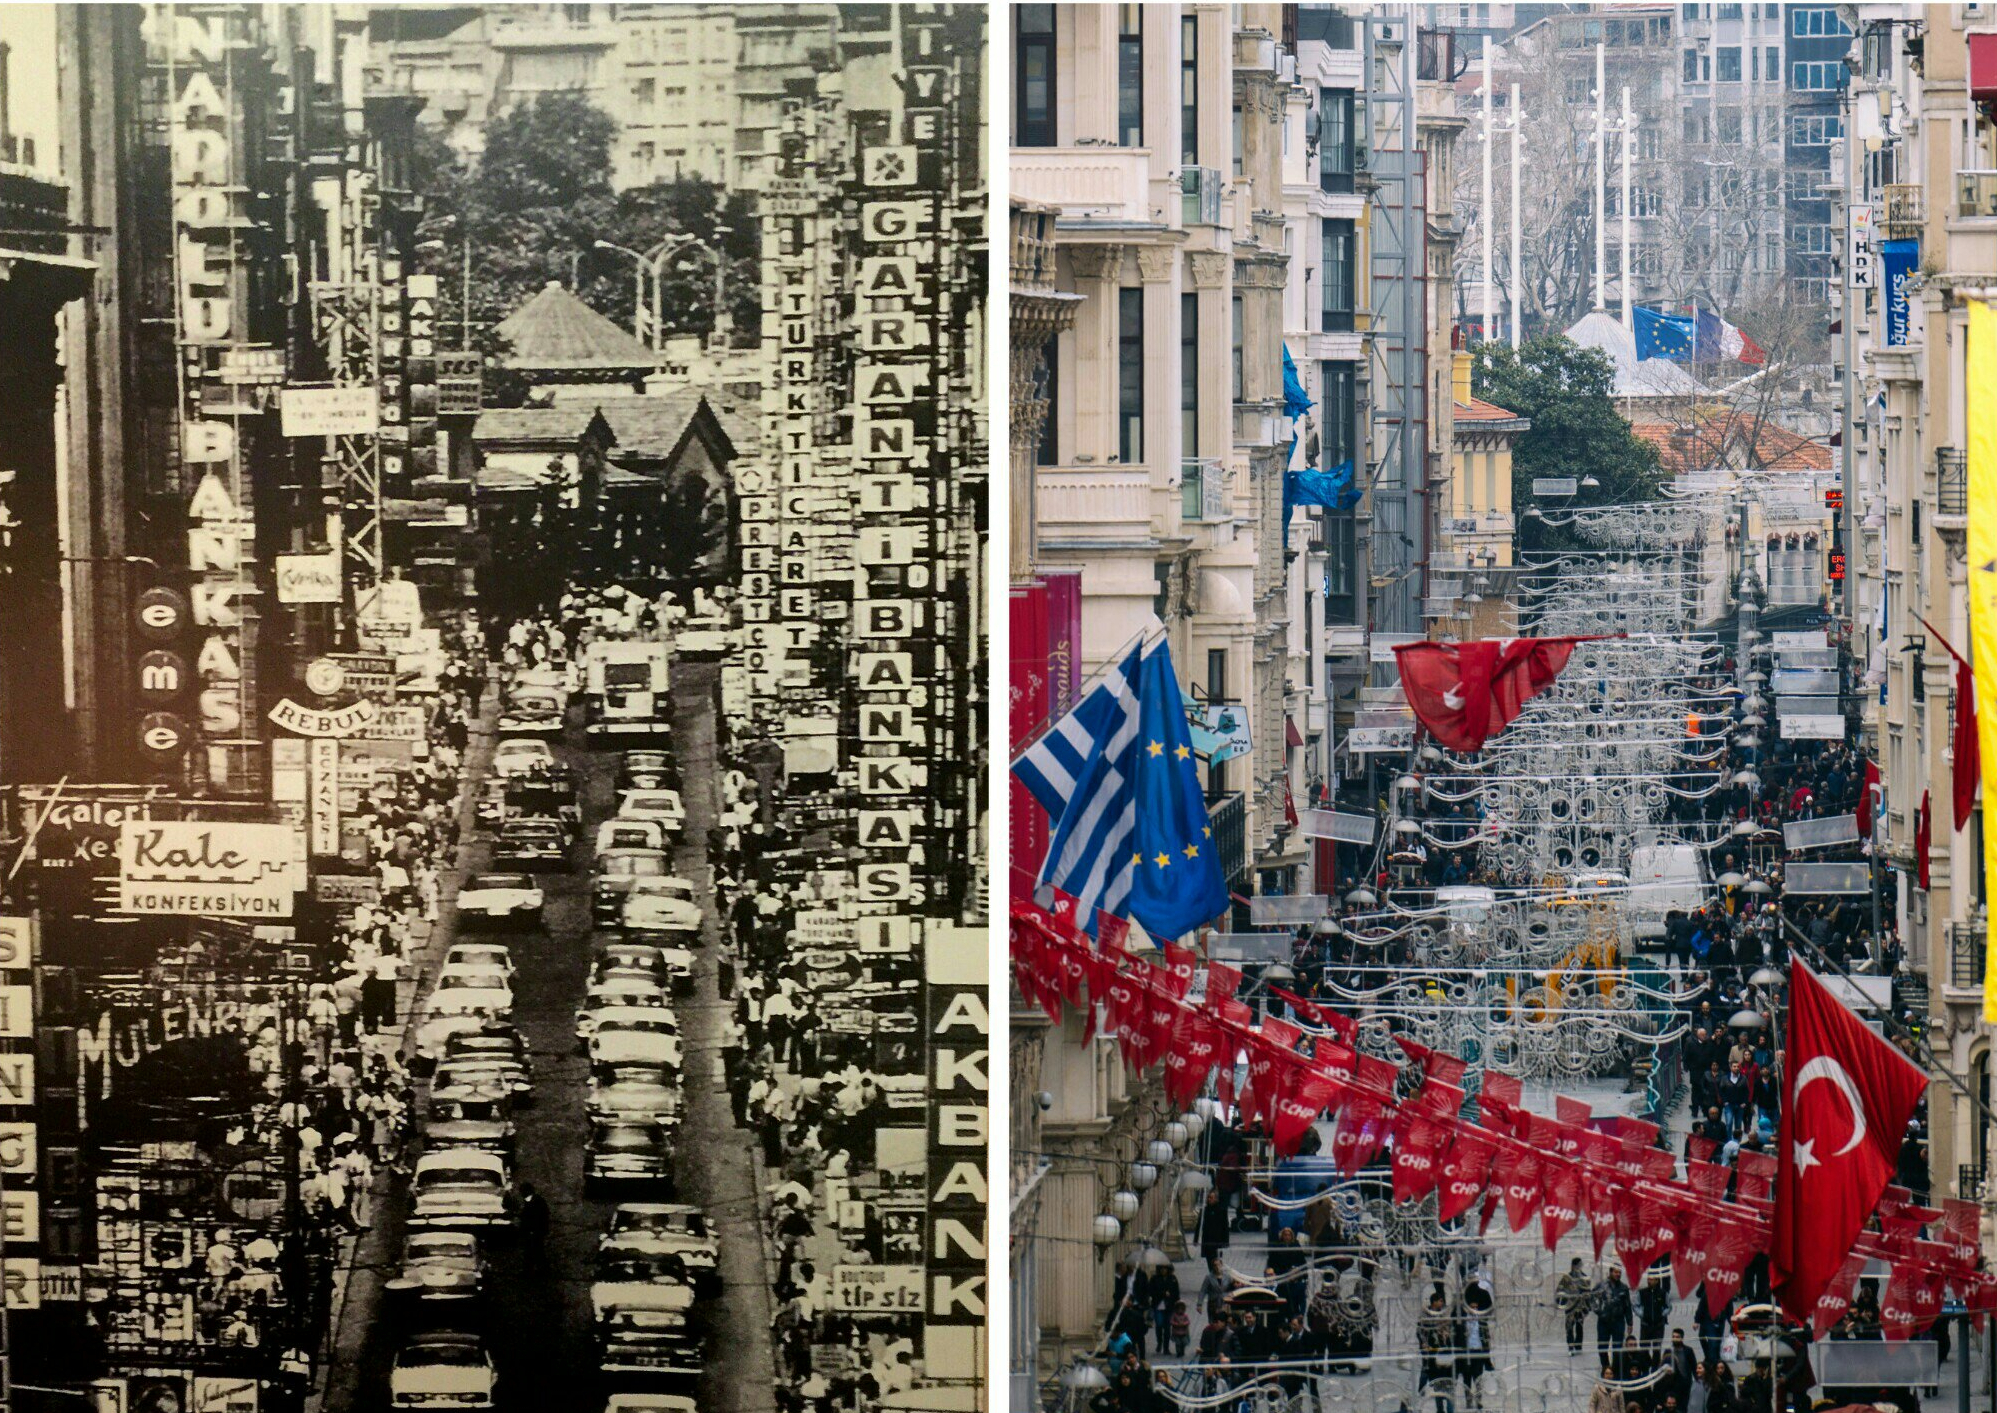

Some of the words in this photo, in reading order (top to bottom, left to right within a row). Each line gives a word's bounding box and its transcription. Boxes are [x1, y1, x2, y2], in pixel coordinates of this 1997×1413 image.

[1855, 241, 1868, 284] HDK
[868, 207, 908, 560] GARANTİ
[277, 705, 373, 734] REBUL
[864, 606, 907, 948] BANKASI
[132, 893, 281, 914] KONFEKSİYON
[933, 992, 988, 1317] AKBANK
[1398, 1154, 1431, 1171] CHP
[1450, 1181, 1480, 1196] CHP
[1543, 1205, 1577, 1221] CHP
[1685, 1248, 1707, 1264] HP
[1706, 1267, 1740, 1285] CHP
[1816, 1294, 1847, 1310] CHP
